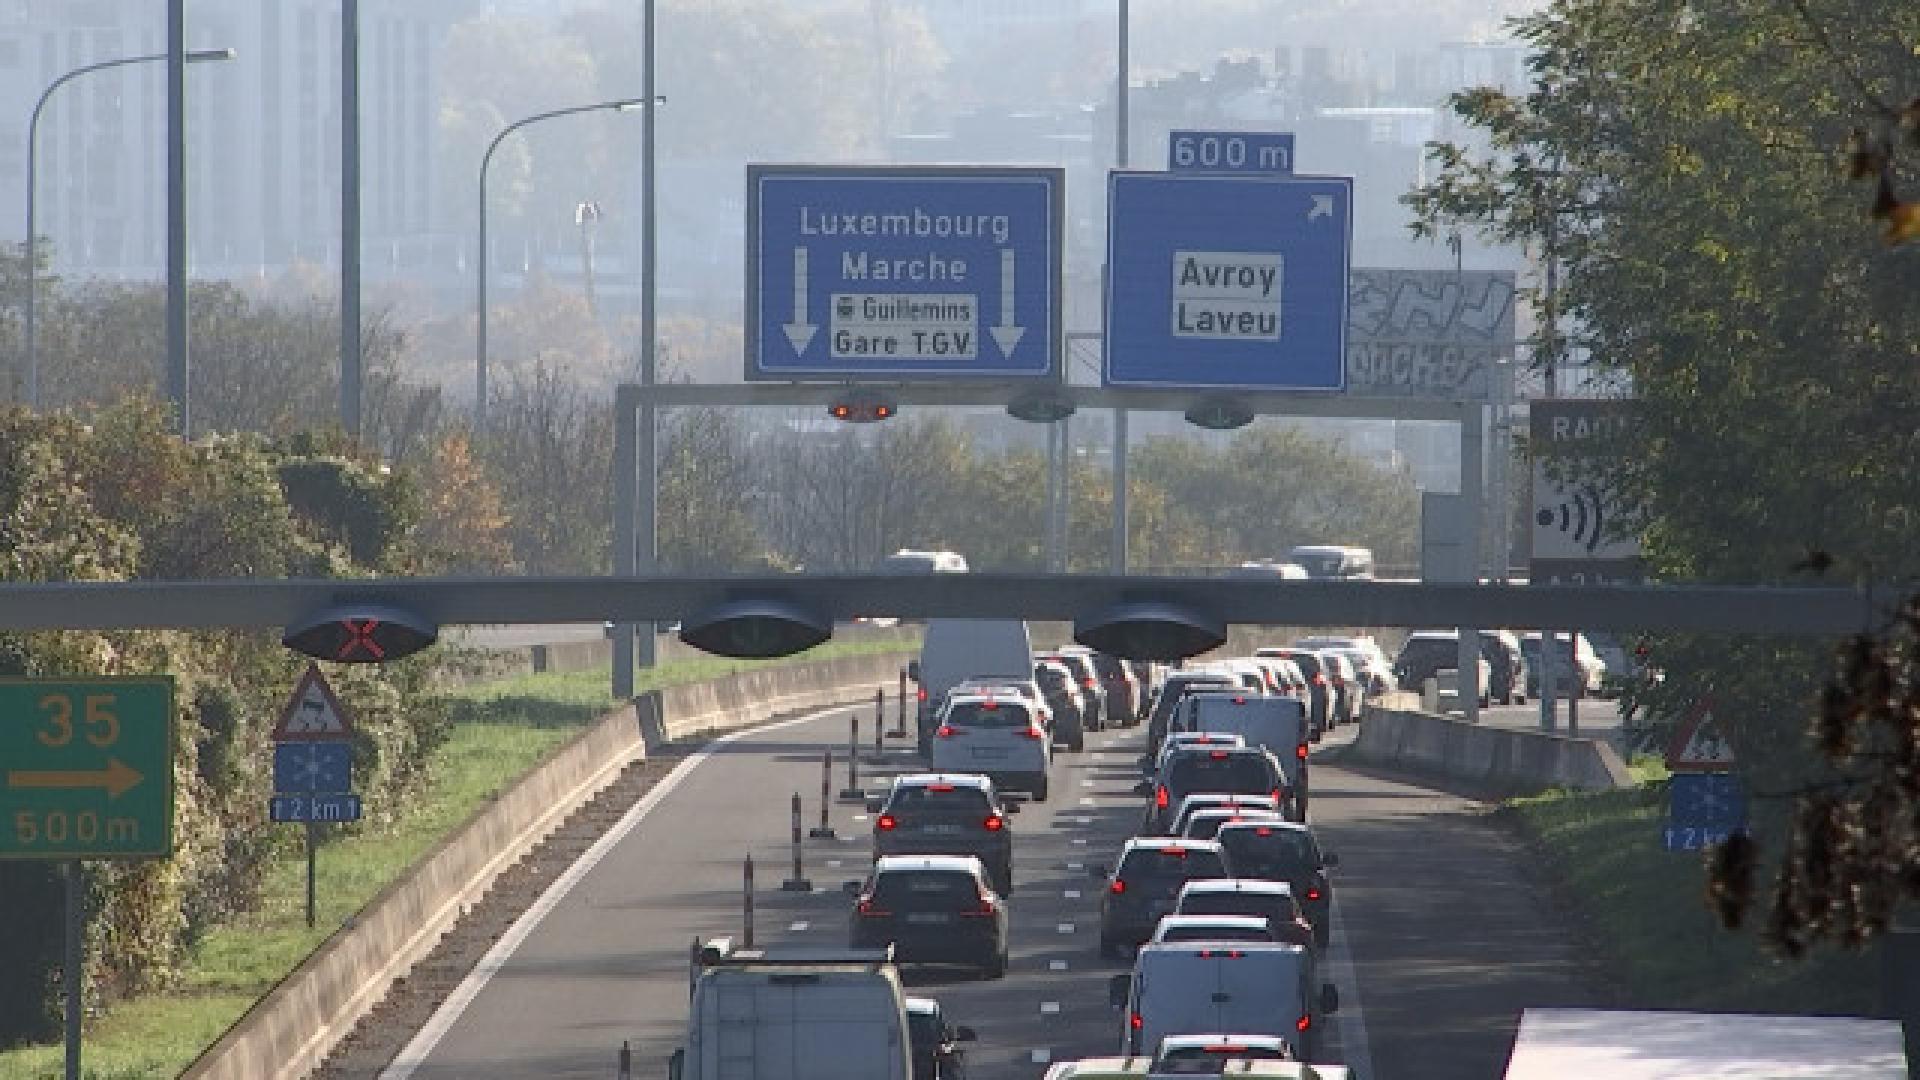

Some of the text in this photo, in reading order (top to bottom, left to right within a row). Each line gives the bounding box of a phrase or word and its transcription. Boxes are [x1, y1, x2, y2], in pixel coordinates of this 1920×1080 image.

[1175, 138, 1287, 168] 600 m
[800, 206, 1009, 243] Luxembourg
[842, 252, 967, 280] Marche
[1180, 258, 1276, 296] Avroy
[863, 297, 970, 321] Guillemins
[1178, 303, 1276, 334] Laveu
[836, 330, 897, 354] Gare
[37, 694, 121, 746] 35
[289, 799, 340, 820] 2 km
[1684, 827, 1696, 850] 2
